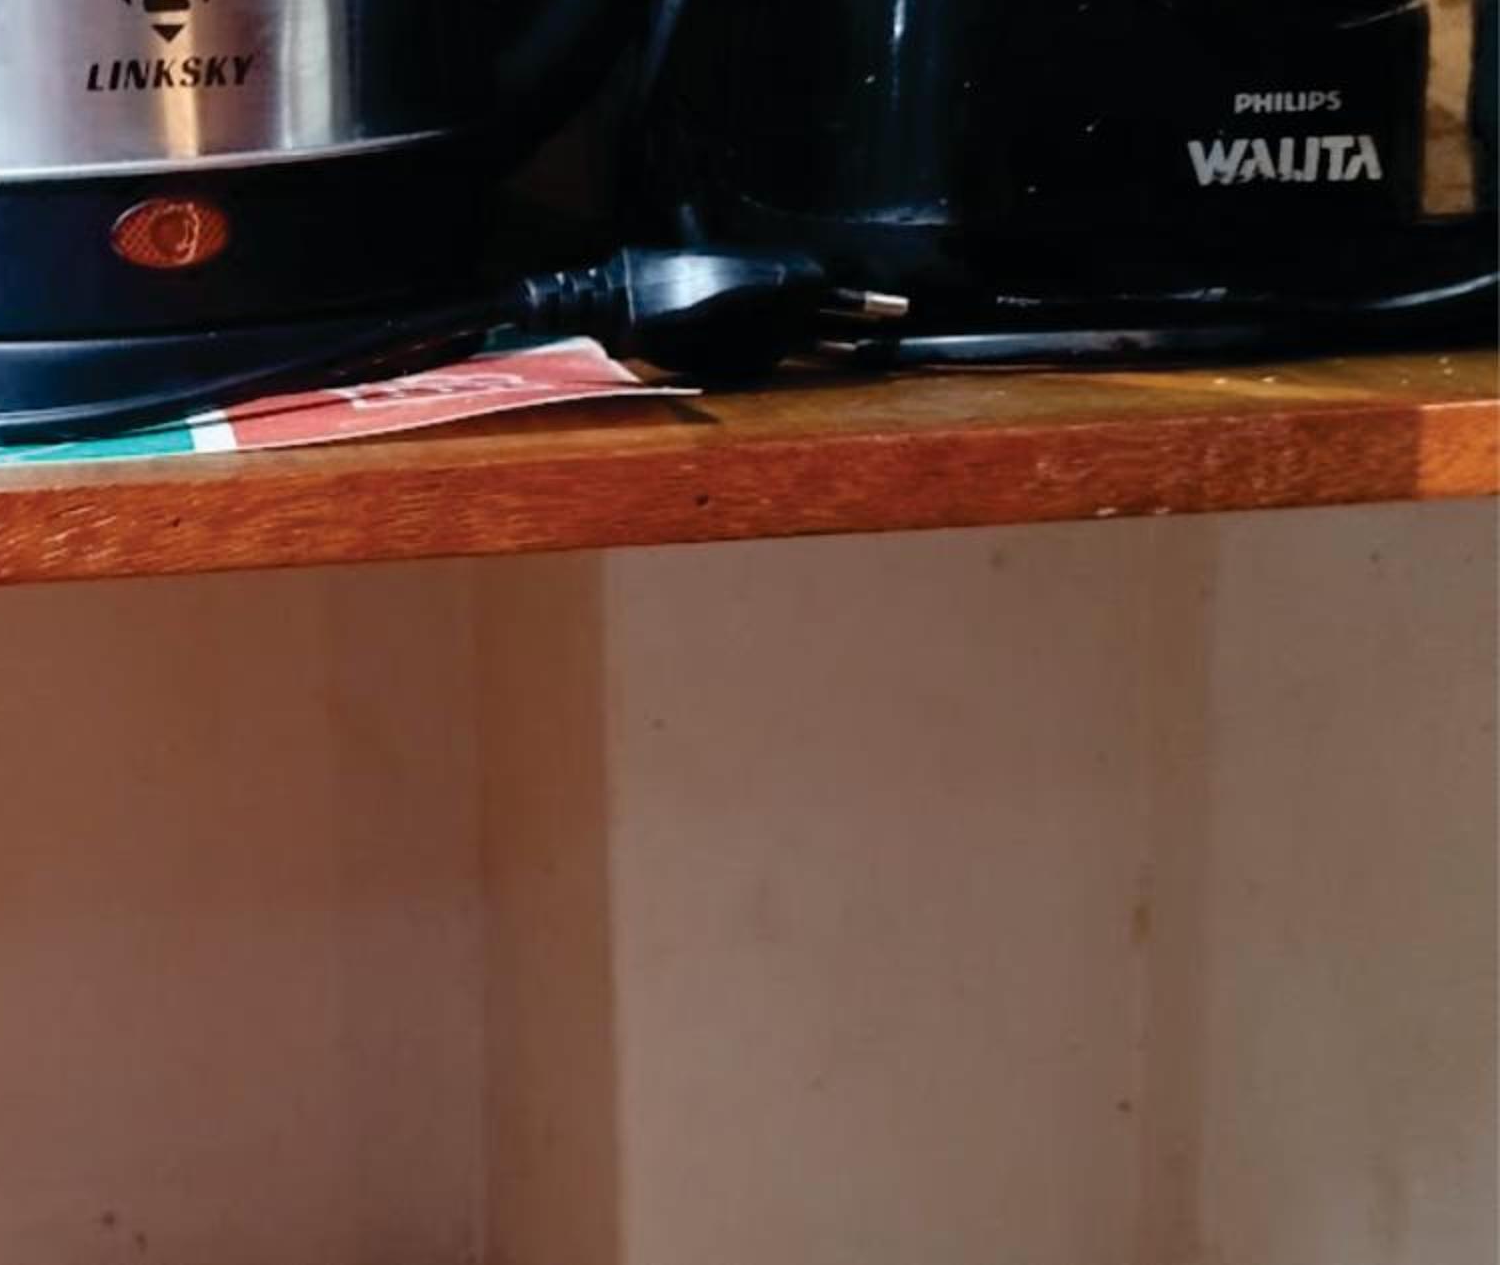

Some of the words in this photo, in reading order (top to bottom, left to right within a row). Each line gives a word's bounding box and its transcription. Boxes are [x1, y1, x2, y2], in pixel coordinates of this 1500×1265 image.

[86, 54, 255, 92] LINKSKY
[1234, 90, 1342, 114] PHILIPS
[1186, 134, 1384, 186] WALITA
